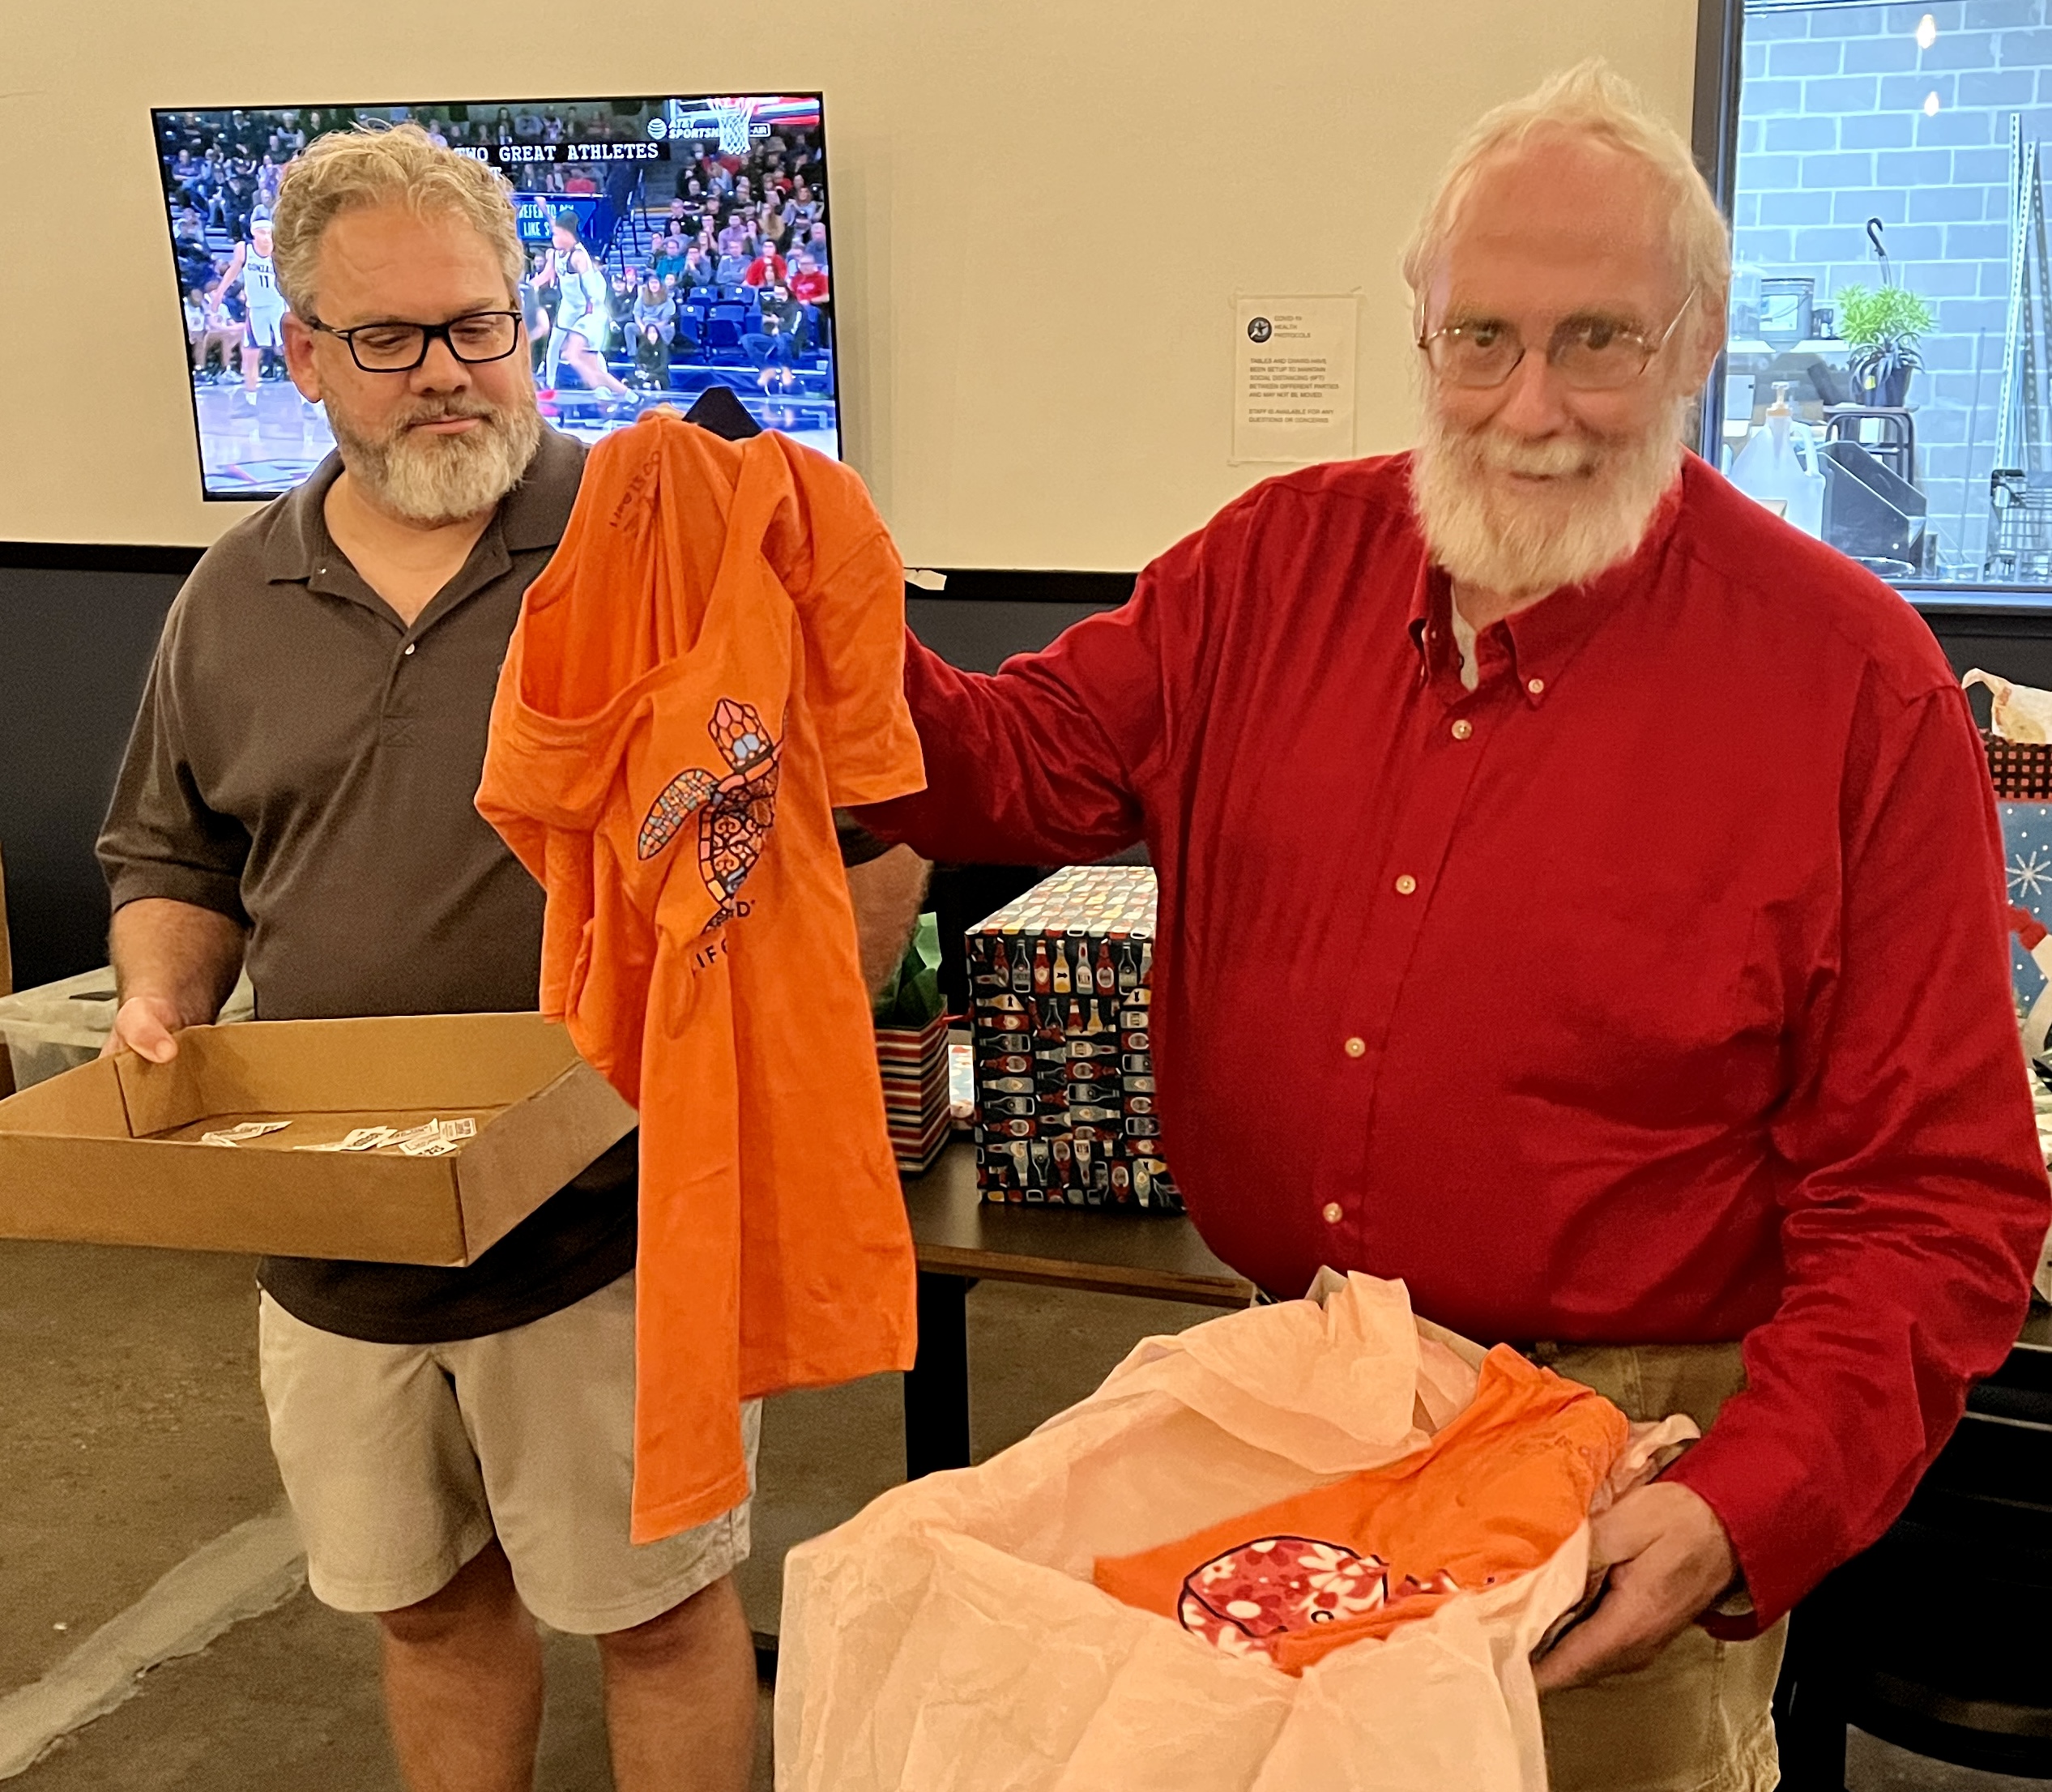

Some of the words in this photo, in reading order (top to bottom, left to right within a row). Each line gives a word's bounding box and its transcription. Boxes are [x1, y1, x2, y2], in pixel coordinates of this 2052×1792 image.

[499, 145, 557, 162] GREAT
[567, 142, 659, 160] ATHLETES
[259, 275, 269, 288] 11
